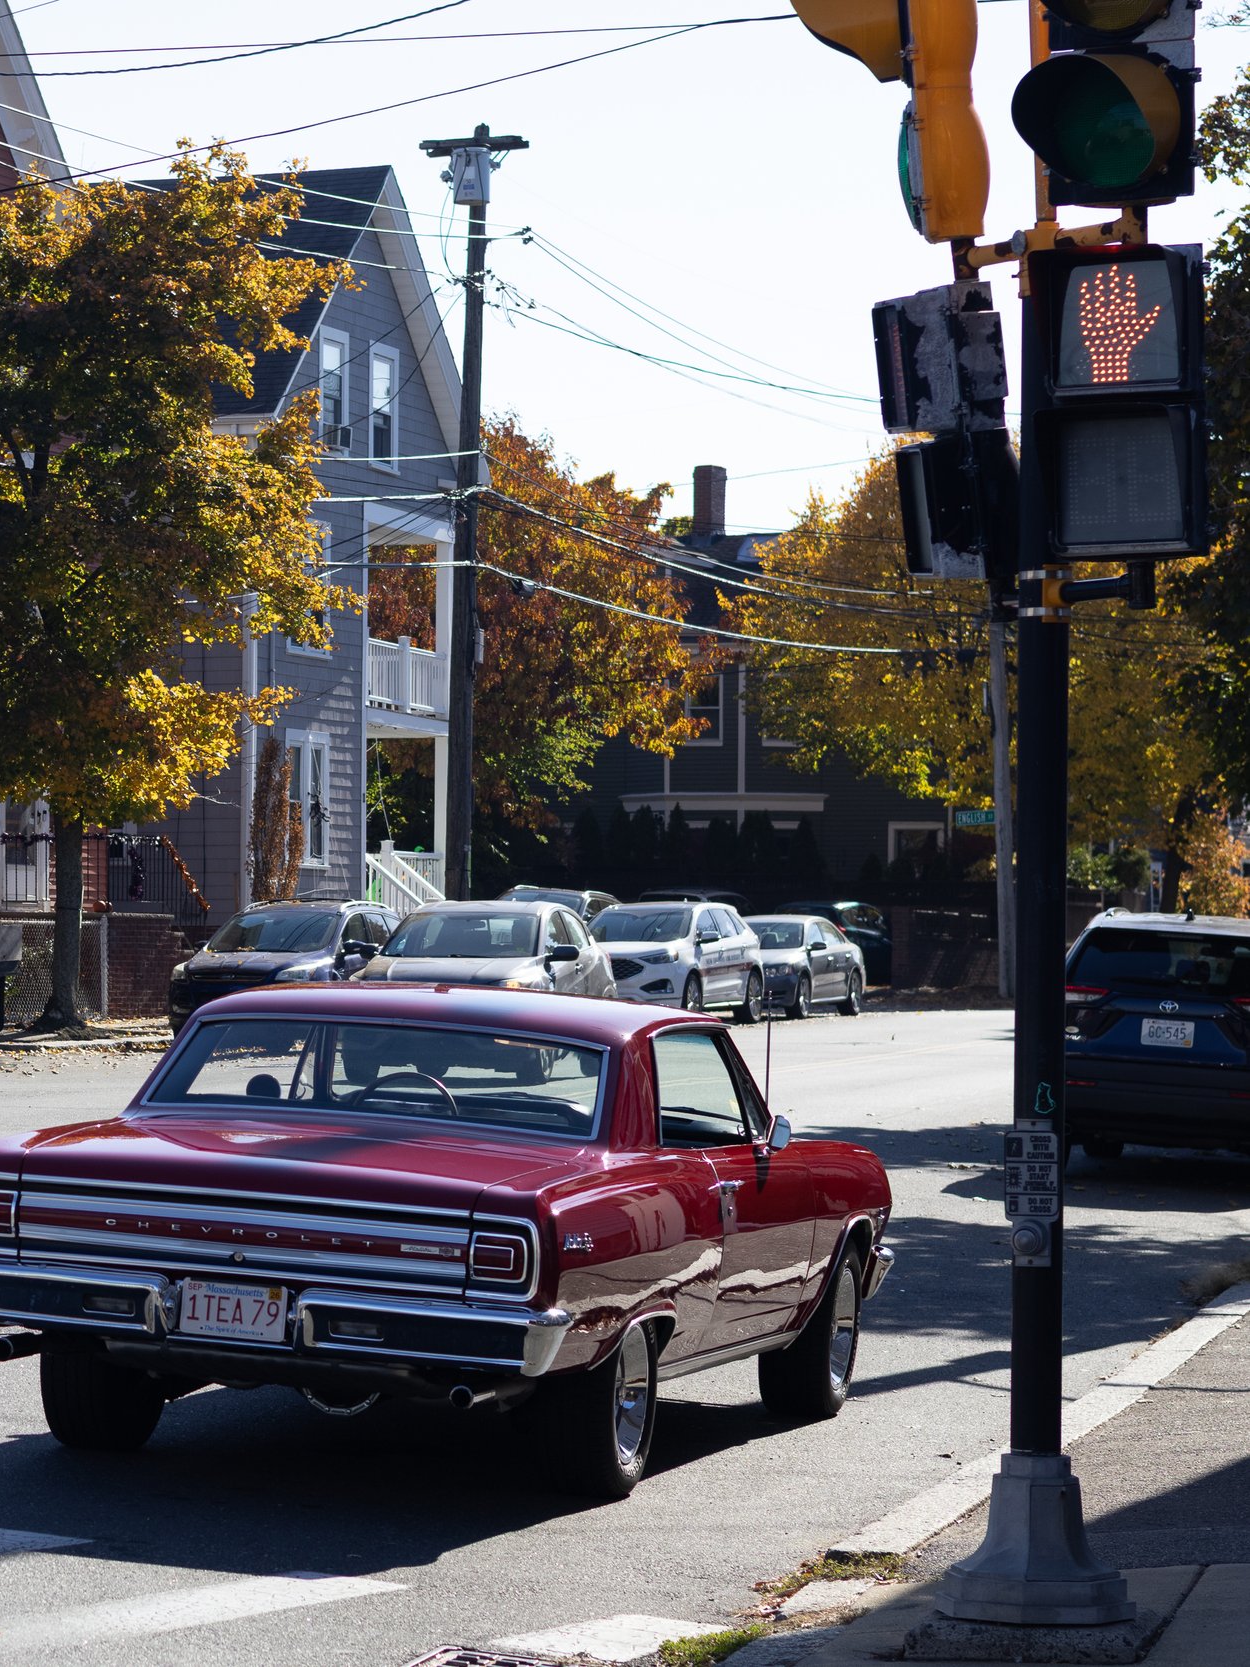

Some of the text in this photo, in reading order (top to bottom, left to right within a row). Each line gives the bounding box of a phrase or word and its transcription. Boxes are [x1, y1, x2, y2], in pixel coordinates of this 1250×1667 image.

[958, 812, 986, 824] ENGLISH
[1033, 1143, 1049, 1151] WITH
[1027, 1152, 1054, 1160] CAUTION
[1027, 1165, 1052, 1173] DO NOT
[1029, 1173, 1049, 1181] START
[1028, 1197, 1053, 1206] DO NOT
[105, 1218, 375, 1248] CHEVROLET
[188, 1282, 281, 1300] SEP Massachusetts 26
[204, 1324, 260, 1337] The Spirit of America
